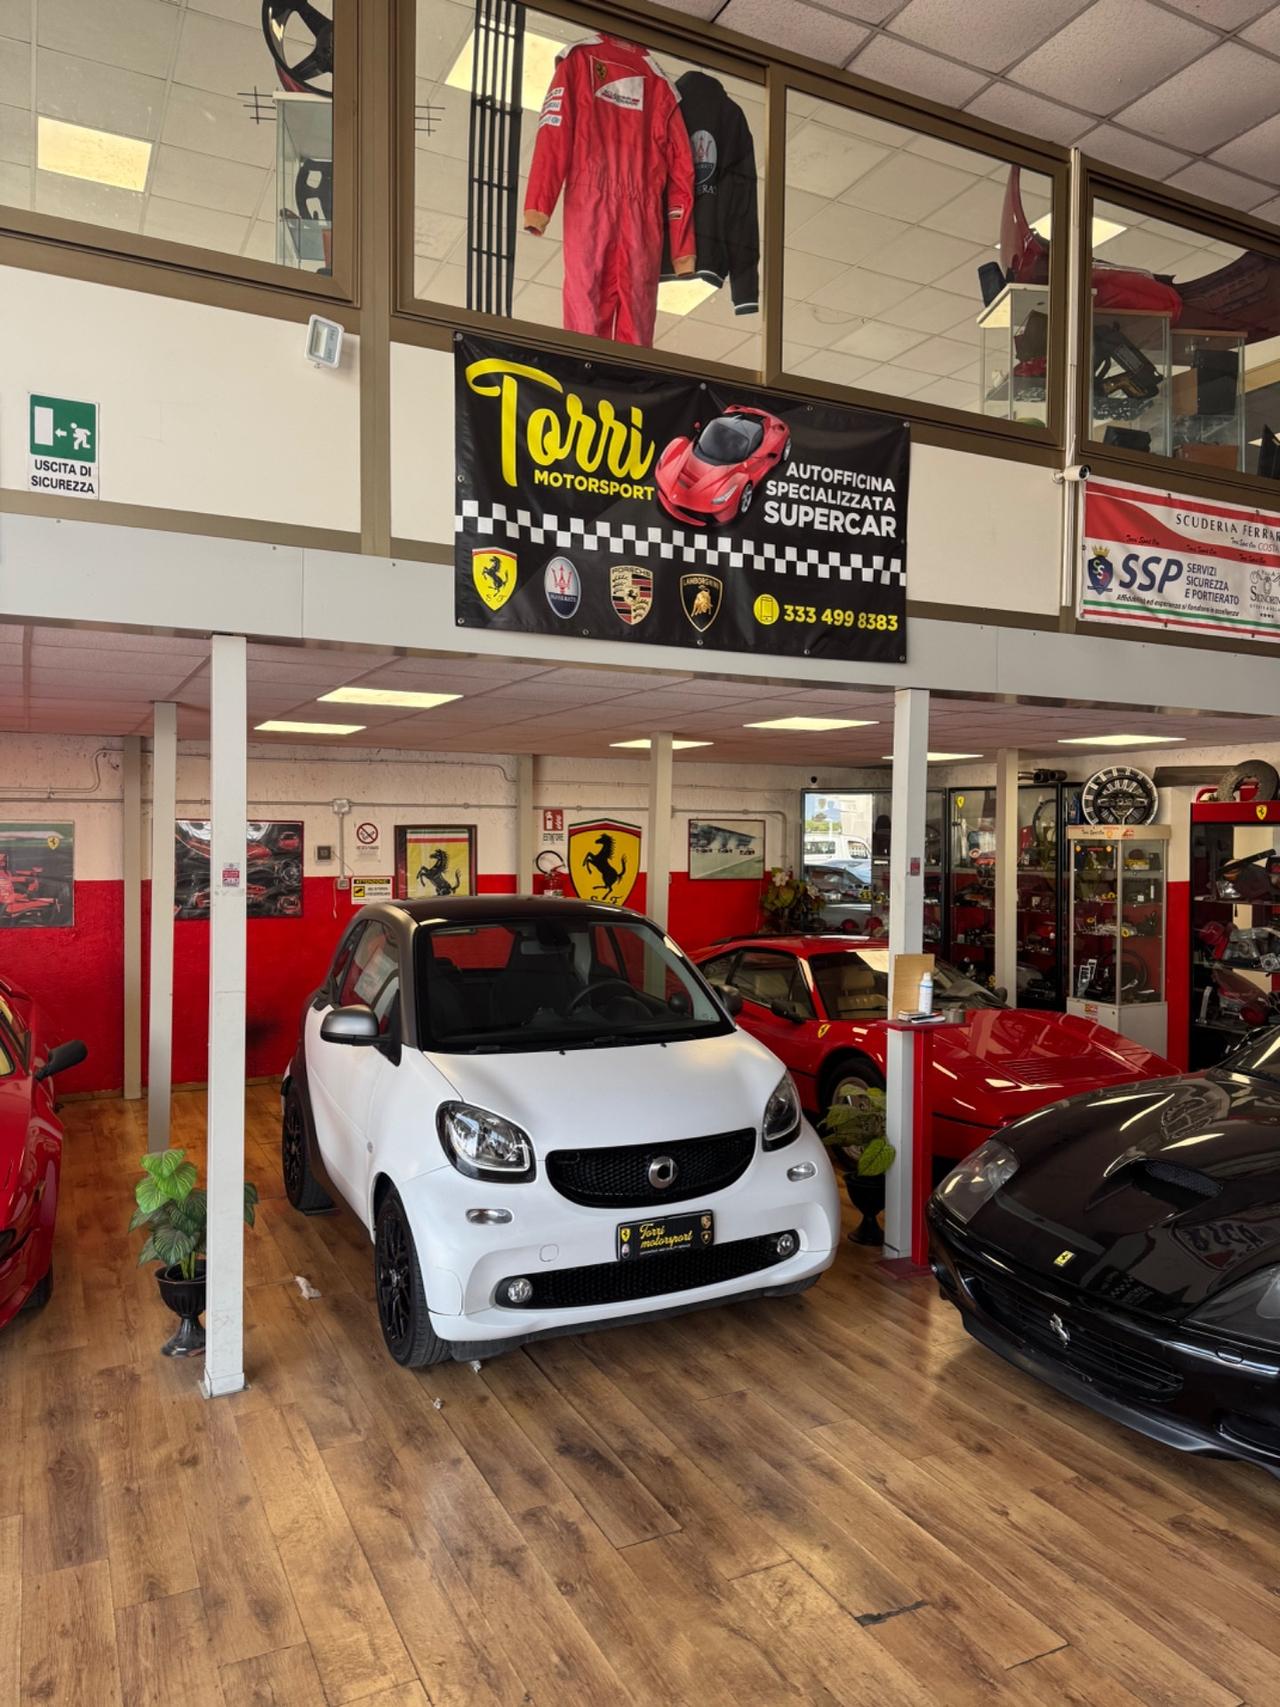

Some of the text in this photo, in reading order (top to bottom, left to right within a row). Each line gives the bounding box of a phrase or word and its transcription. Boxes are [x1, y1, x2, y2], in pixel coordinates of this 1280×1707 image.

[465, 358, 656, 487] Torri
[34, 459, 92, 477] USCITA DI
[786, 462, 896, 493] AUTOFFICINA
[31, 475, 95, 494] SICUREZZA
[534, 469, 655, 500] MOTORSPORT
[766, 480, 896, 512] SPECIALIZZATA
[764, 501, 897, 538] SUPERCAR
[1176, 513, 1239, 534] SCUDERIA
[1118, 553, 1184, 594] SSP
[1186, 562, 1217, 577] SERVIZI
[1186, 575, 1230, 591] SICUREZZA
[1185, 588, 1191, 599] E
[1192, 590, 1240, 606] PORTIERATO
[784, 605, 898, 631] 333 499 8383
[640, 1223, 665, 1239] Torri
[640, 1230, 693, 1248] motorsport
